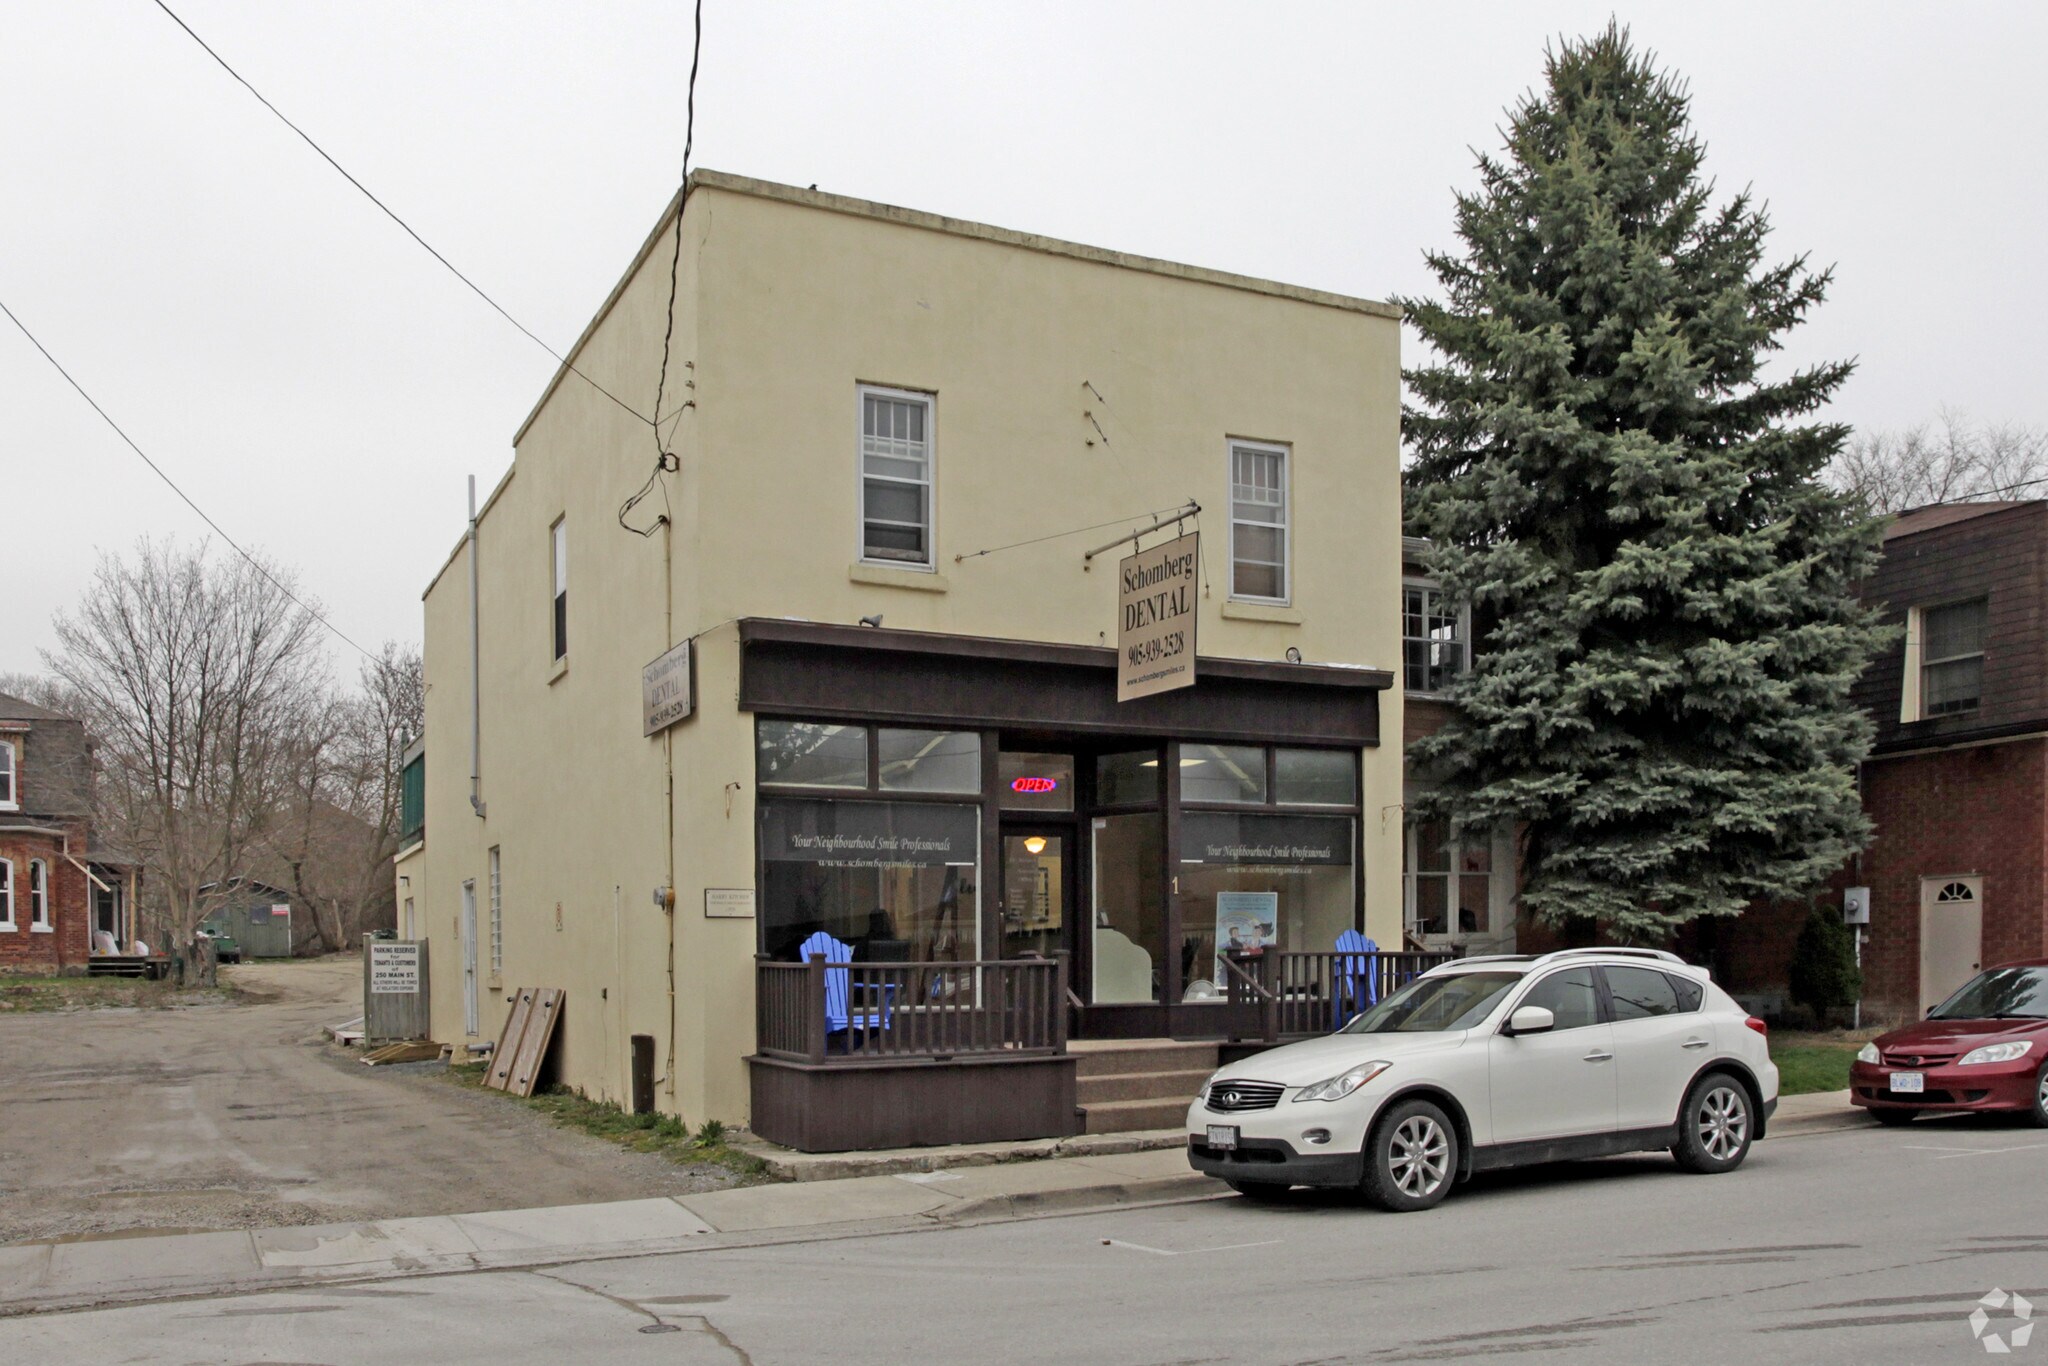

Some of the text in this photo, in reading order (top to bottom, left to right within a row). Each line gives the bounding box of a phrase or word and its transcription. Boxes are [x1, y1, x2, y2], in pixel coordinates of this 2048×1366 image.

[1124, 553, 1192, 594] Schomberg
[1125, 586, 1190, 632] DENTAL
[1128, 630, 1184, 668] 905-939-2528
[645, 648, 687, 685] Schomberg
[1126, 665, 1185, 686] www.schombergsmiles.ca
[652, 676, 681, 708] DENTAL
[1014, 777, 1056, 792] OPEN
[792, 834, 951, 854] Your Neighbourhood Smile Professionals
[1206, 844, 1331, 861] Your Neighbourhood Smile Professionals
[817, 858, 927, 871] www.schombergsmiles.ca
